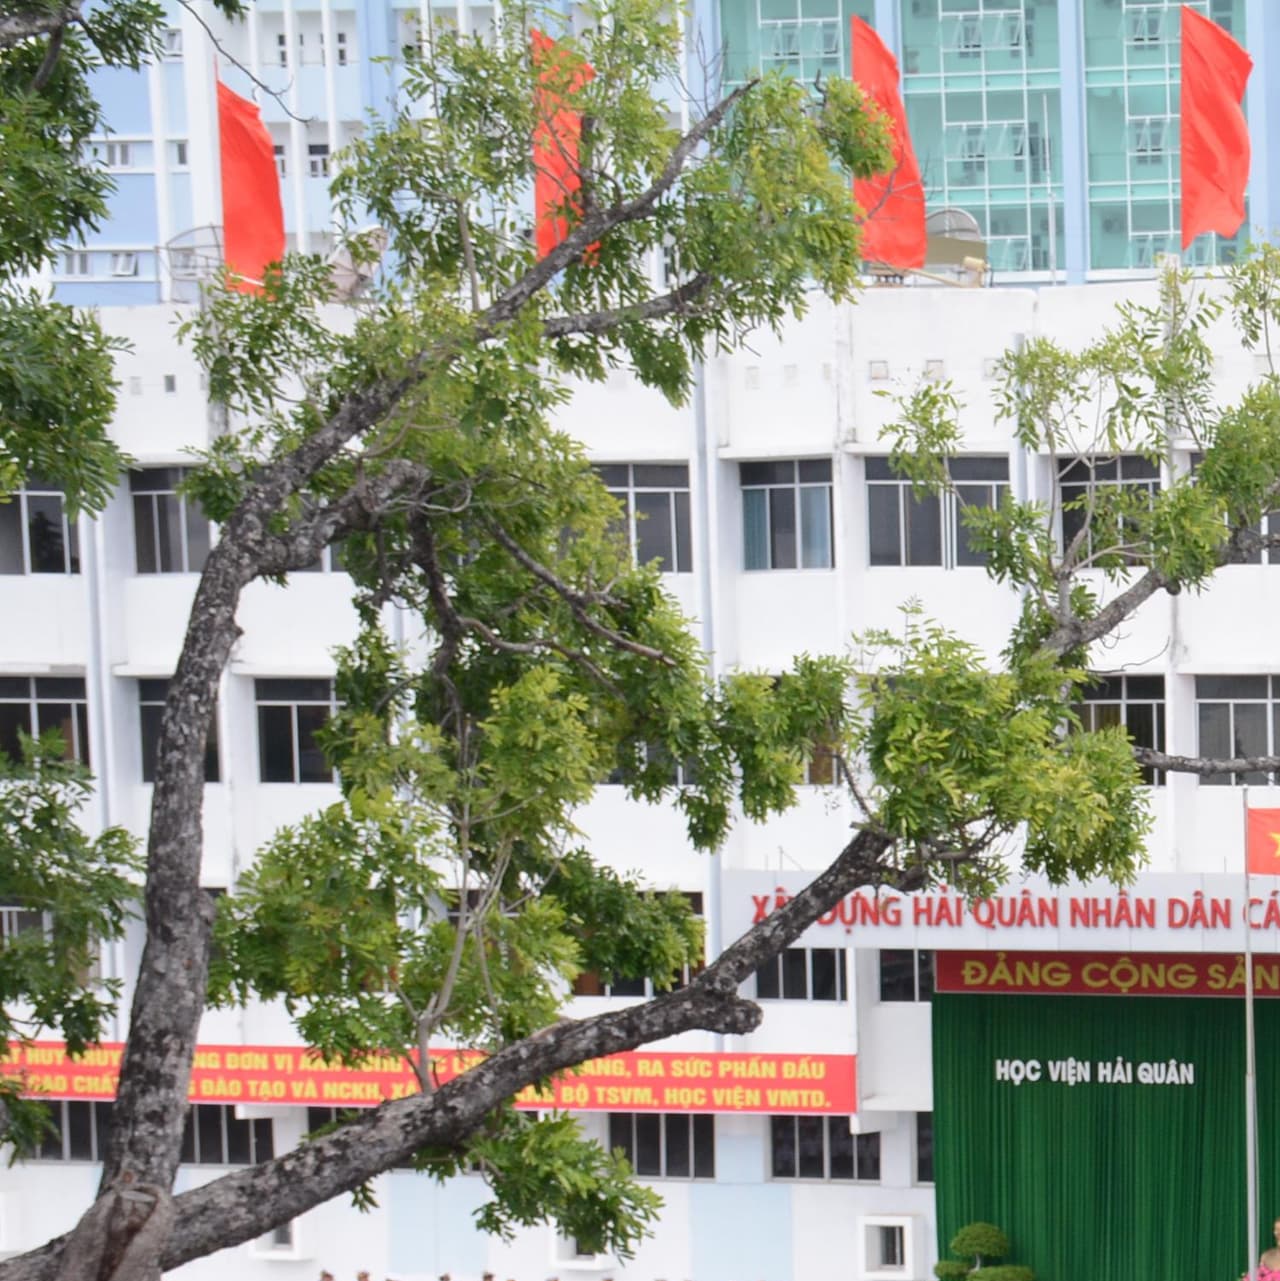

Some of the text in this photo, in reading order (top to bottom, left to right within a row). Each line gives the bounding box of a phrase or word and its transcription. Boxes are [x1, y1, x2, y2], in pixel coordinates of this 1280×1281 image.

[752, 886, 793, 924] XÂ
[913, 885, 964, 926] HẢI
[973, 889, 1058, 930] QUÂN
[1070, 889, 1156, 929] NHÂN
[1168, 890, 1232, 929] DÂN
[961, 952, 1072, 987] ĐẢNG
[1081, 957, 1198, 993] CỘNG
[1207, 955, 1279, 990] SẢN
[636, 1059, 665, 1077] RA
[671, 1056, 713, 1078] SỨC
[718, 1056, 777, 1079] PHẤN
[996, 1056, 1194, 1086] HỌC VIỆN HẢI QUÂN
[561, 1082, 589, 1107] BỘ
[664, 1087, 707, 1109] HỌC
[712, 1085, 761, 1109] VIỆN
